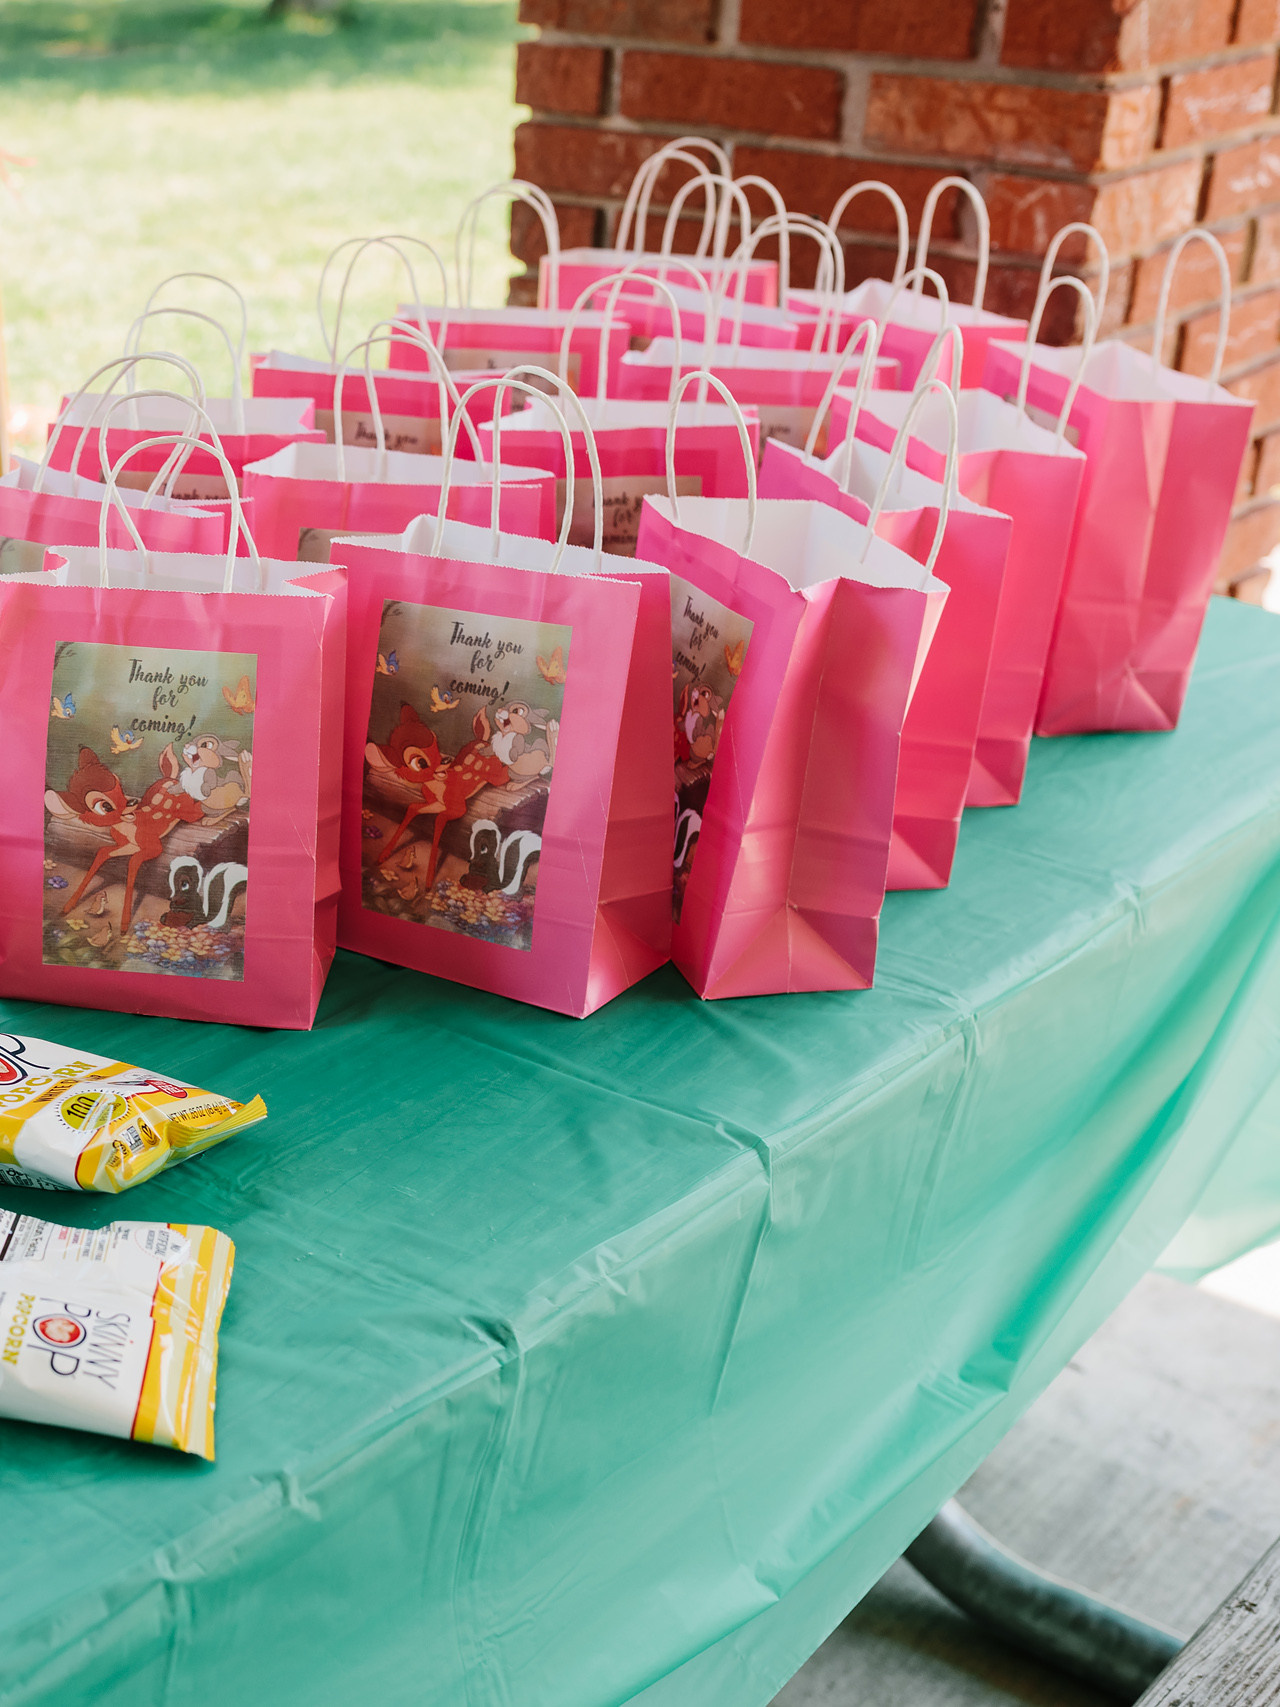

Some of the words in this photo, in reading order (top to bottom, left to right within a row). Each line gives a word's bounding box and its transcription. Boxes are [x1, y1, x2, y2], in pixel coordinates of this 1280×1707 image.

[683, 595, 705, 628] Thank
[702, 622, 719, 642] you
[450, 621, 493, 649] Thank
[494, 640, 525, 661] you
[689, 627, 704, 651] for
[128, 658, 174, 684] Thank
[177, 674, 209, 695] you
[470, 650, 496, 674] for
[676, 651, 707, 683] coming!
[152, 686, 179, 711] for
[449, 678, 510, 706] coming!
[130, 714, 197, 742] coming!
[66, 1095, 100, 1120] 100
[1, 1292, 36, 1366] POPCORN
[27, 1297, 91, 1377] POP
